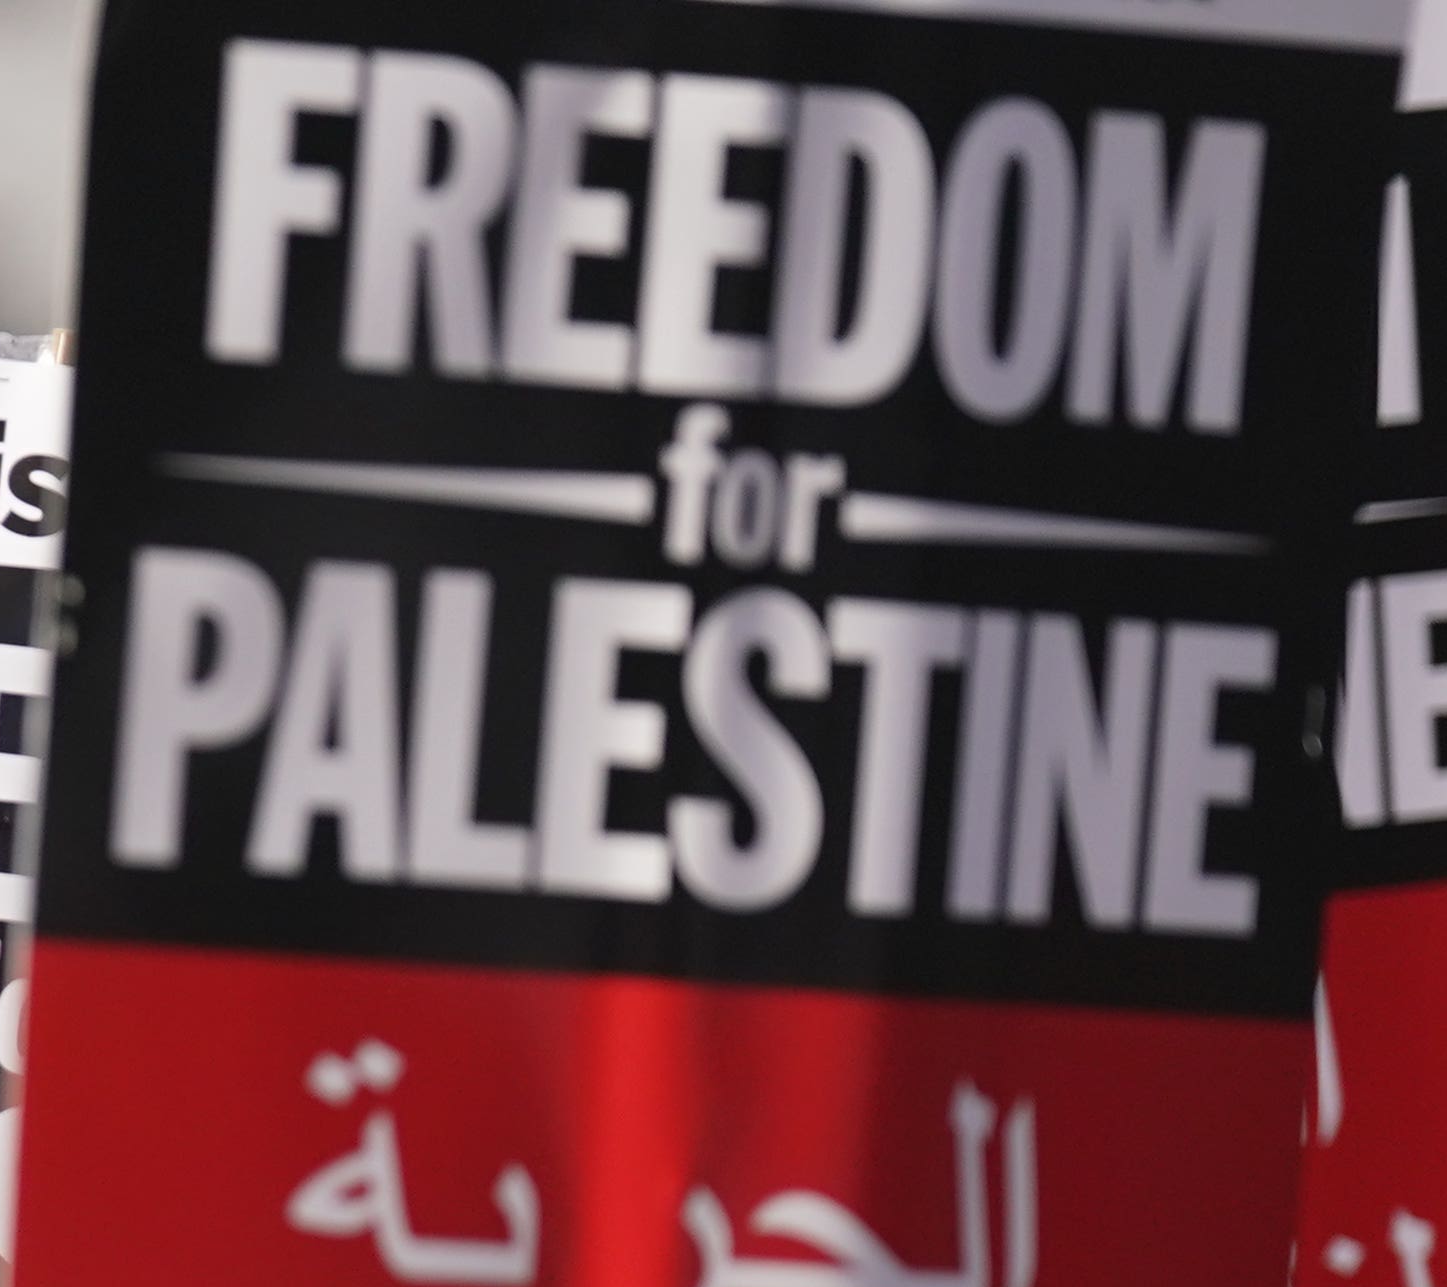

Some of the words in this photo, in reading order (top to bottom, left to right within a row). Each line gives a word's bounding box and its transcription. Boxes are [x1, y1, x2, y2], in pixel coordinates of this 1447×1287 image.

[204, 36, 1267, 434] FREEDOM
[660, 403, 851, 574] for
[110, 546, 1279, 937] PALESTINE
